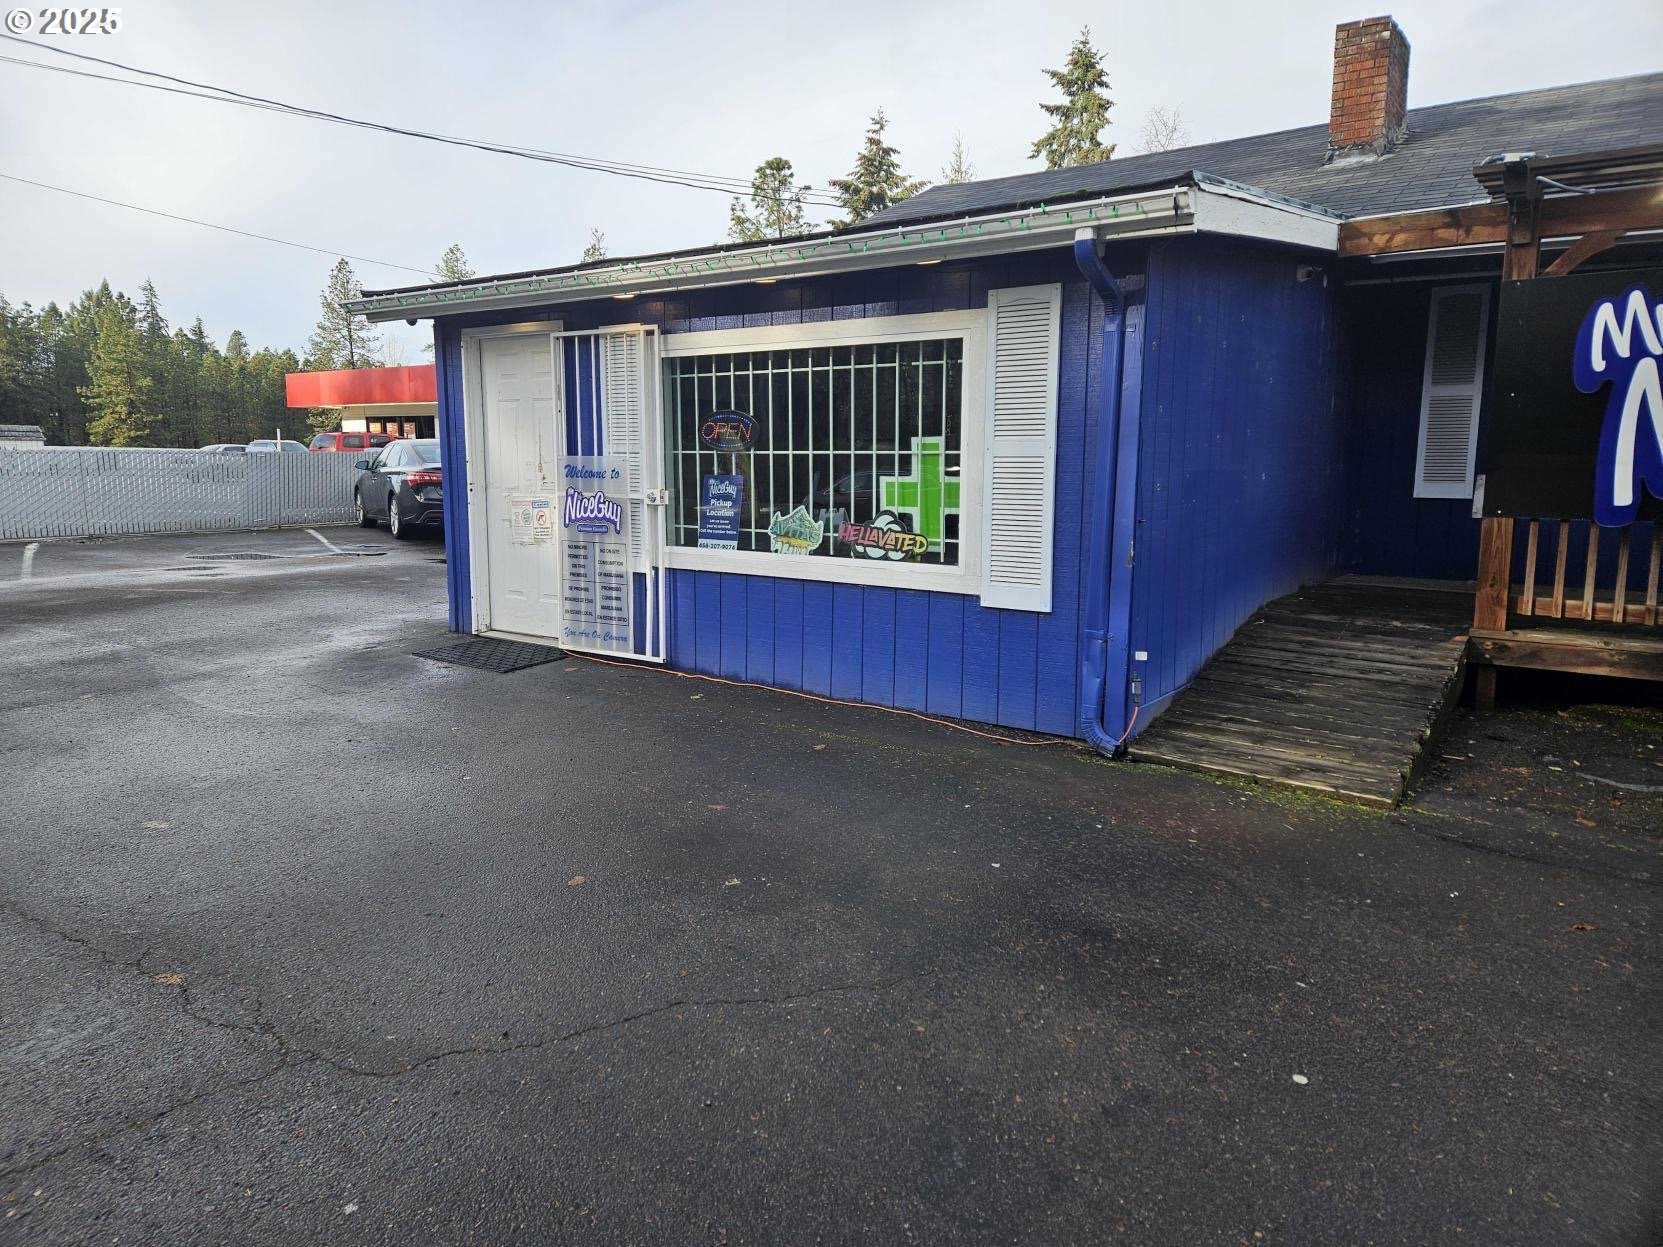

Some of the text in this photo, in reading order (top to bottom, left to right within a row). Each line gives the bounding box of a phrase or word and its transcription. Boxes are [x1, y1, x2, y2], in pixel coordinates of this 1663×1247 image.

[702, 422, 752, 441] OPEN
[564, 464, 620, 479] Welcome to
[565, 491, 621, 532] NiceGuy
[710, 499, 733, 508] Pickup
[706, 509, 735, 517] Location
[840, 523, 928, 553] HELLAVATED
